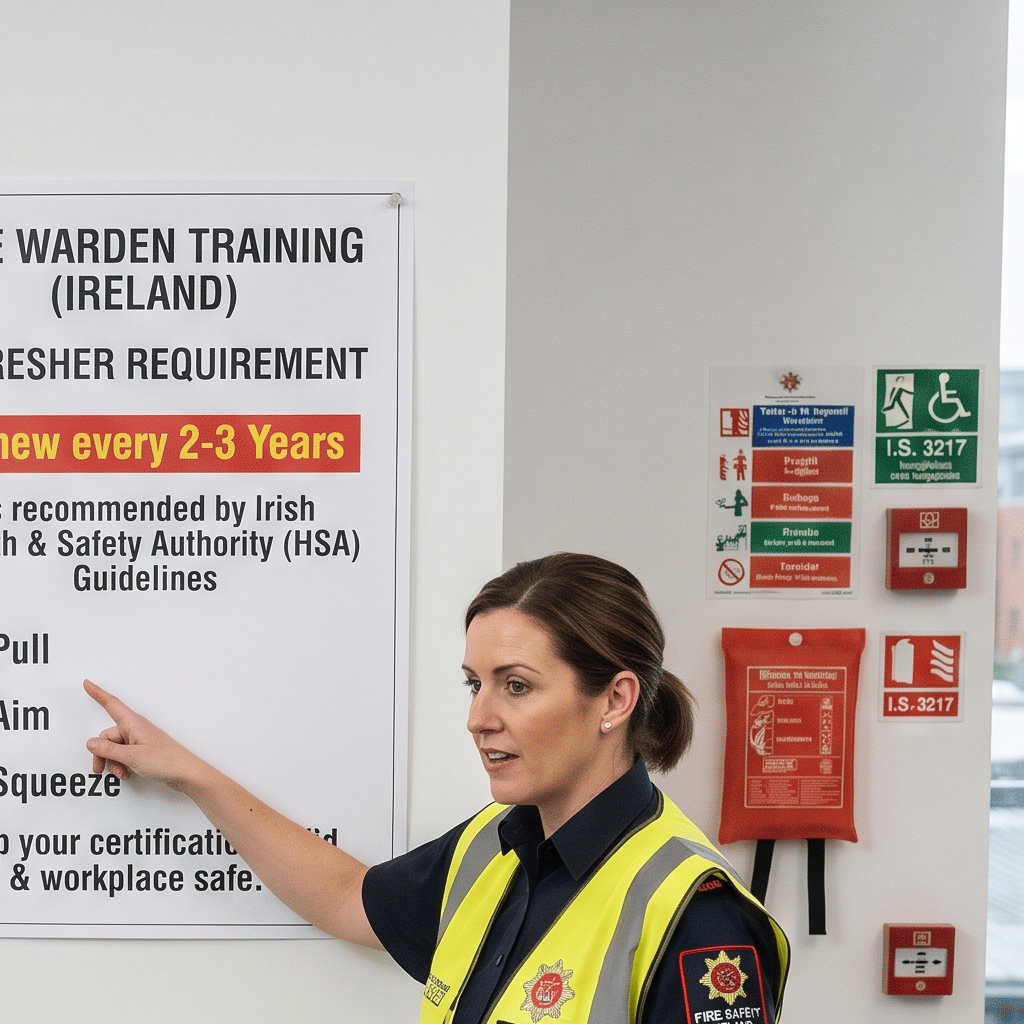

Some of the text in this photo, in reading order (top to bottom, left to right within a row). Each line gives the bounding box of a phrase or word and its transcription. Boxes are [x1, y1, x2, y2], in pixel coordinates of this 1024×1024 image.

[16, 228, 174, 263] WARDEN
[189, 227, 362, 263] TRAINING
[52, 275, 236, 318] (IRELAND)
[128, 348, 368, 381] REQUIREMENT
[73, 433, 167, 468] every
[180, 424, 235, 459] 2-3
[247, 424, 344, 459] Years
[888, 439, 967, 456] I.S. 3217
[13, 495, 204, 521] recommended
[216, 495, 246, 527] by
[257, 495, 314, 521] Irish
[28, 530, 46, 556] &
[58, 530, 141, 562] Safety
[151, 530, 273, 562] Authority
[284, 530, 359, 562] (HSA)
[74, 565, 216, 591] Guidelines
[917, 696, 955, 712] 3217
[19, 834, 80, 861] your
[91, 828, 238, 855] certificatio
[11, 864, 261, 897] & workplace safe.
[694, 1010, 724, 1024] FIRE
